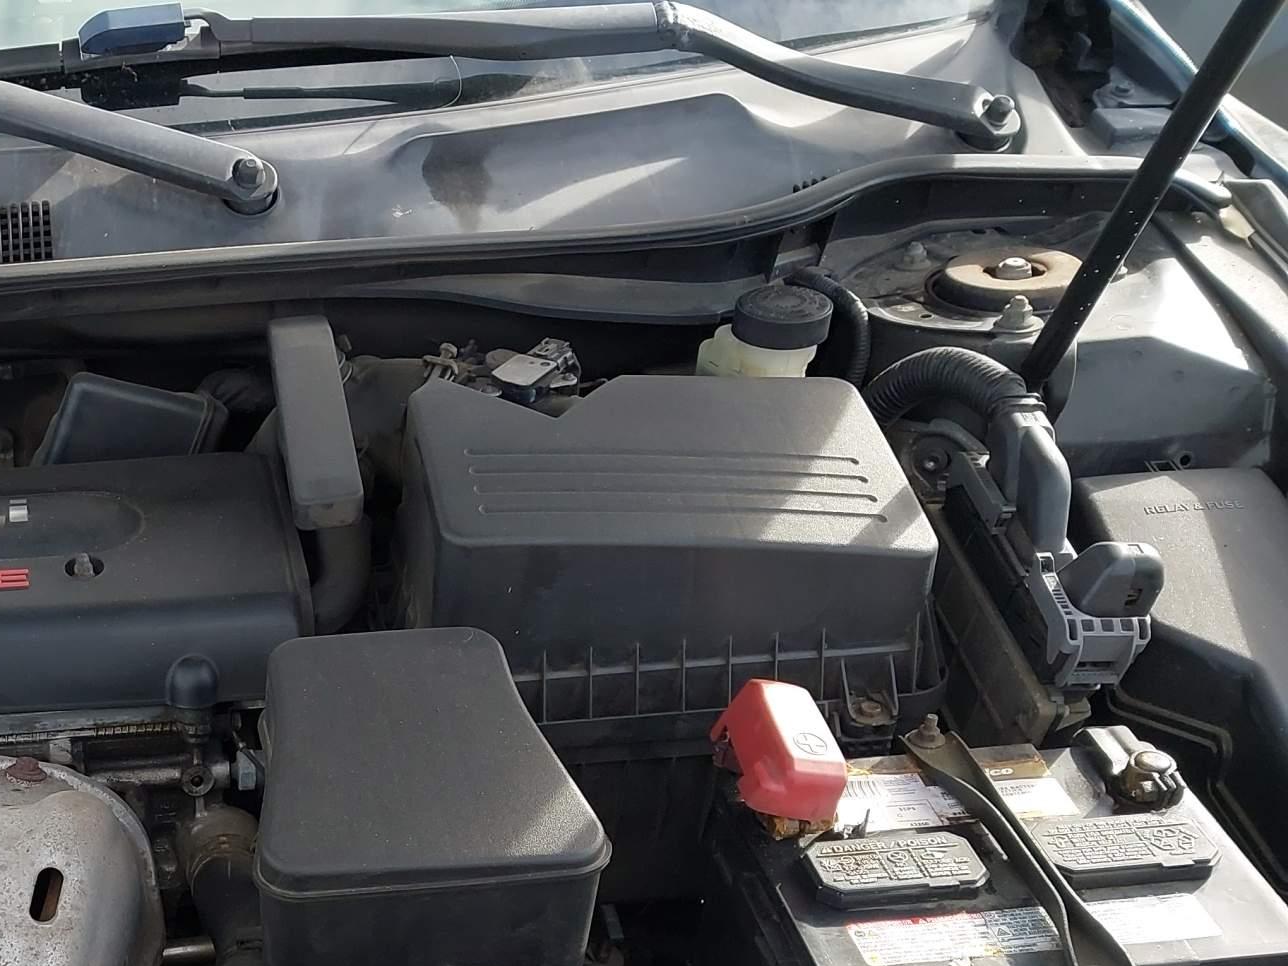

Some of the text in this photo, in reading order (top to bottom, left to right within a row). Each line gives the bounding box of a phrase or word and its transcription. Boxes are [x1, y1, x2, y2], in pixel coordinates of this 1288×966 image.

[1143, 500, 1245, 516] RELAY & FUSE
[833, 840, 885, 854] DANGER
[899, 835, 948, 848] POISON
